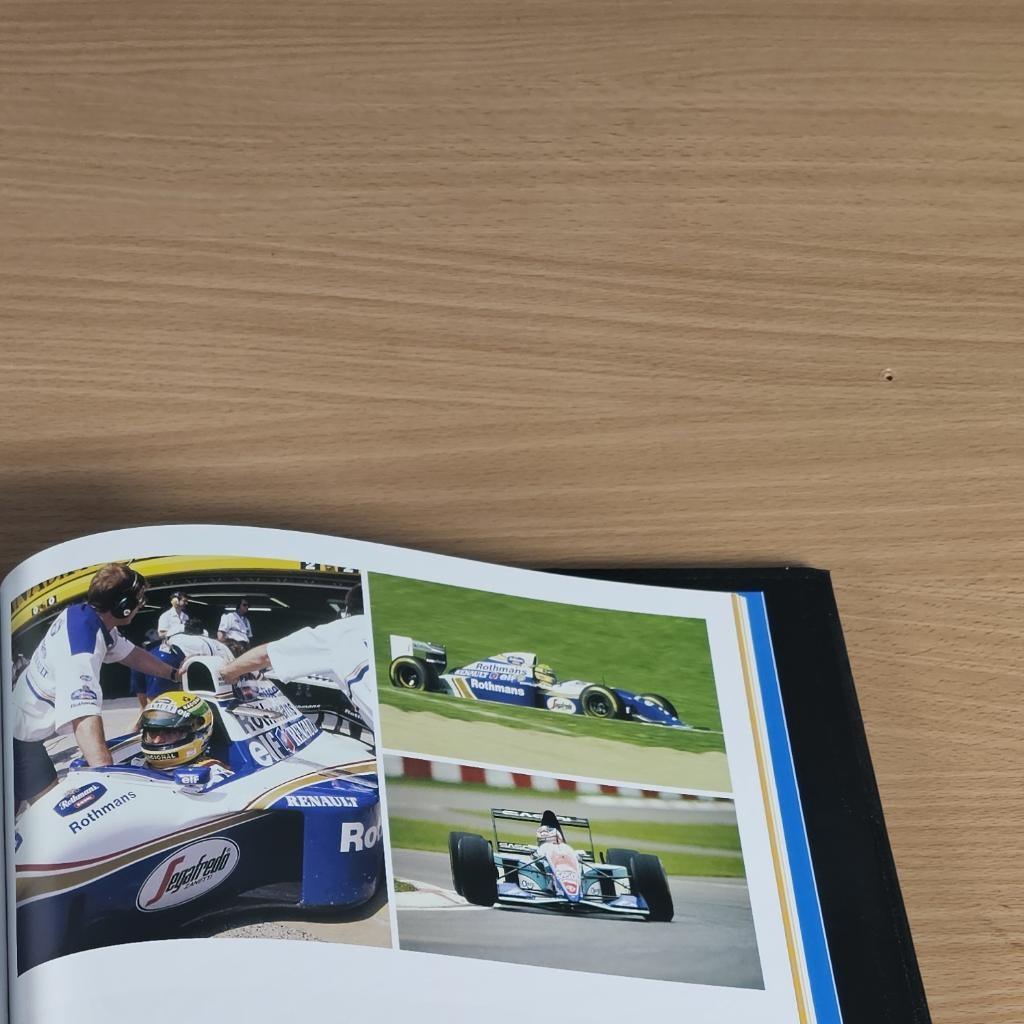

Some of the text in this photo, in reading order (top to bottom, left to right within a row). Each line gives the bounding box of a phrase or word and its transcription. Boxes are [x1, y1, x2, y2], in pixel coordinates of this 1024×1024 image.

[470, 678, 525, 697] Rothmans
[68, 791, 137, 834] Rothmans
[285, 795, 359, 808] RENAULT
[339, 821, 383, 853] Ro
[145, 846, 231, 907] Segafredo
